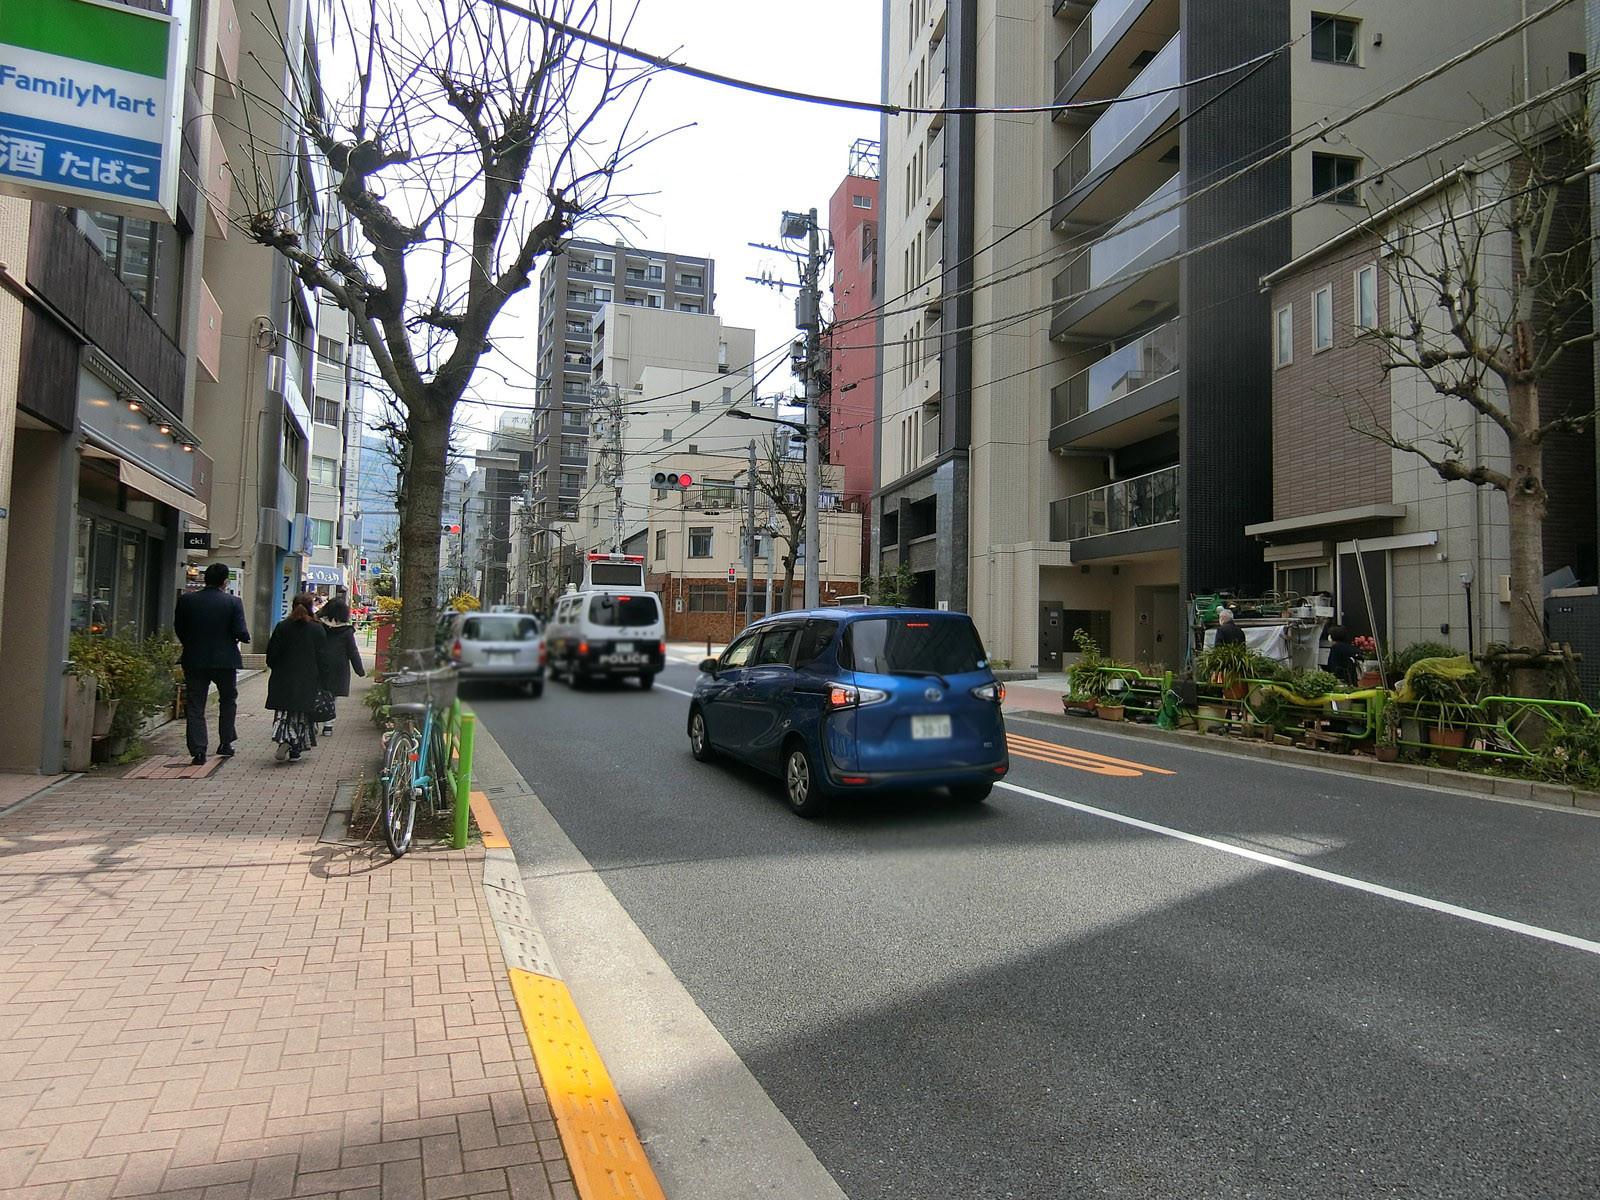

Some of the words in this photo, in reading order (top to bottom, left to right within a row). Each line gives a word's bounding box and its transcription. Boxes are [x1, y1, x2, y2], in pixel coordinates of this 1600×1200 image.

[0, 64, 156, 117] FamilyMart
[0, 134, 46, 176] 酒
[59, 151, 150, 191] たばこ
[599, 653, 649, 664] POLICE
